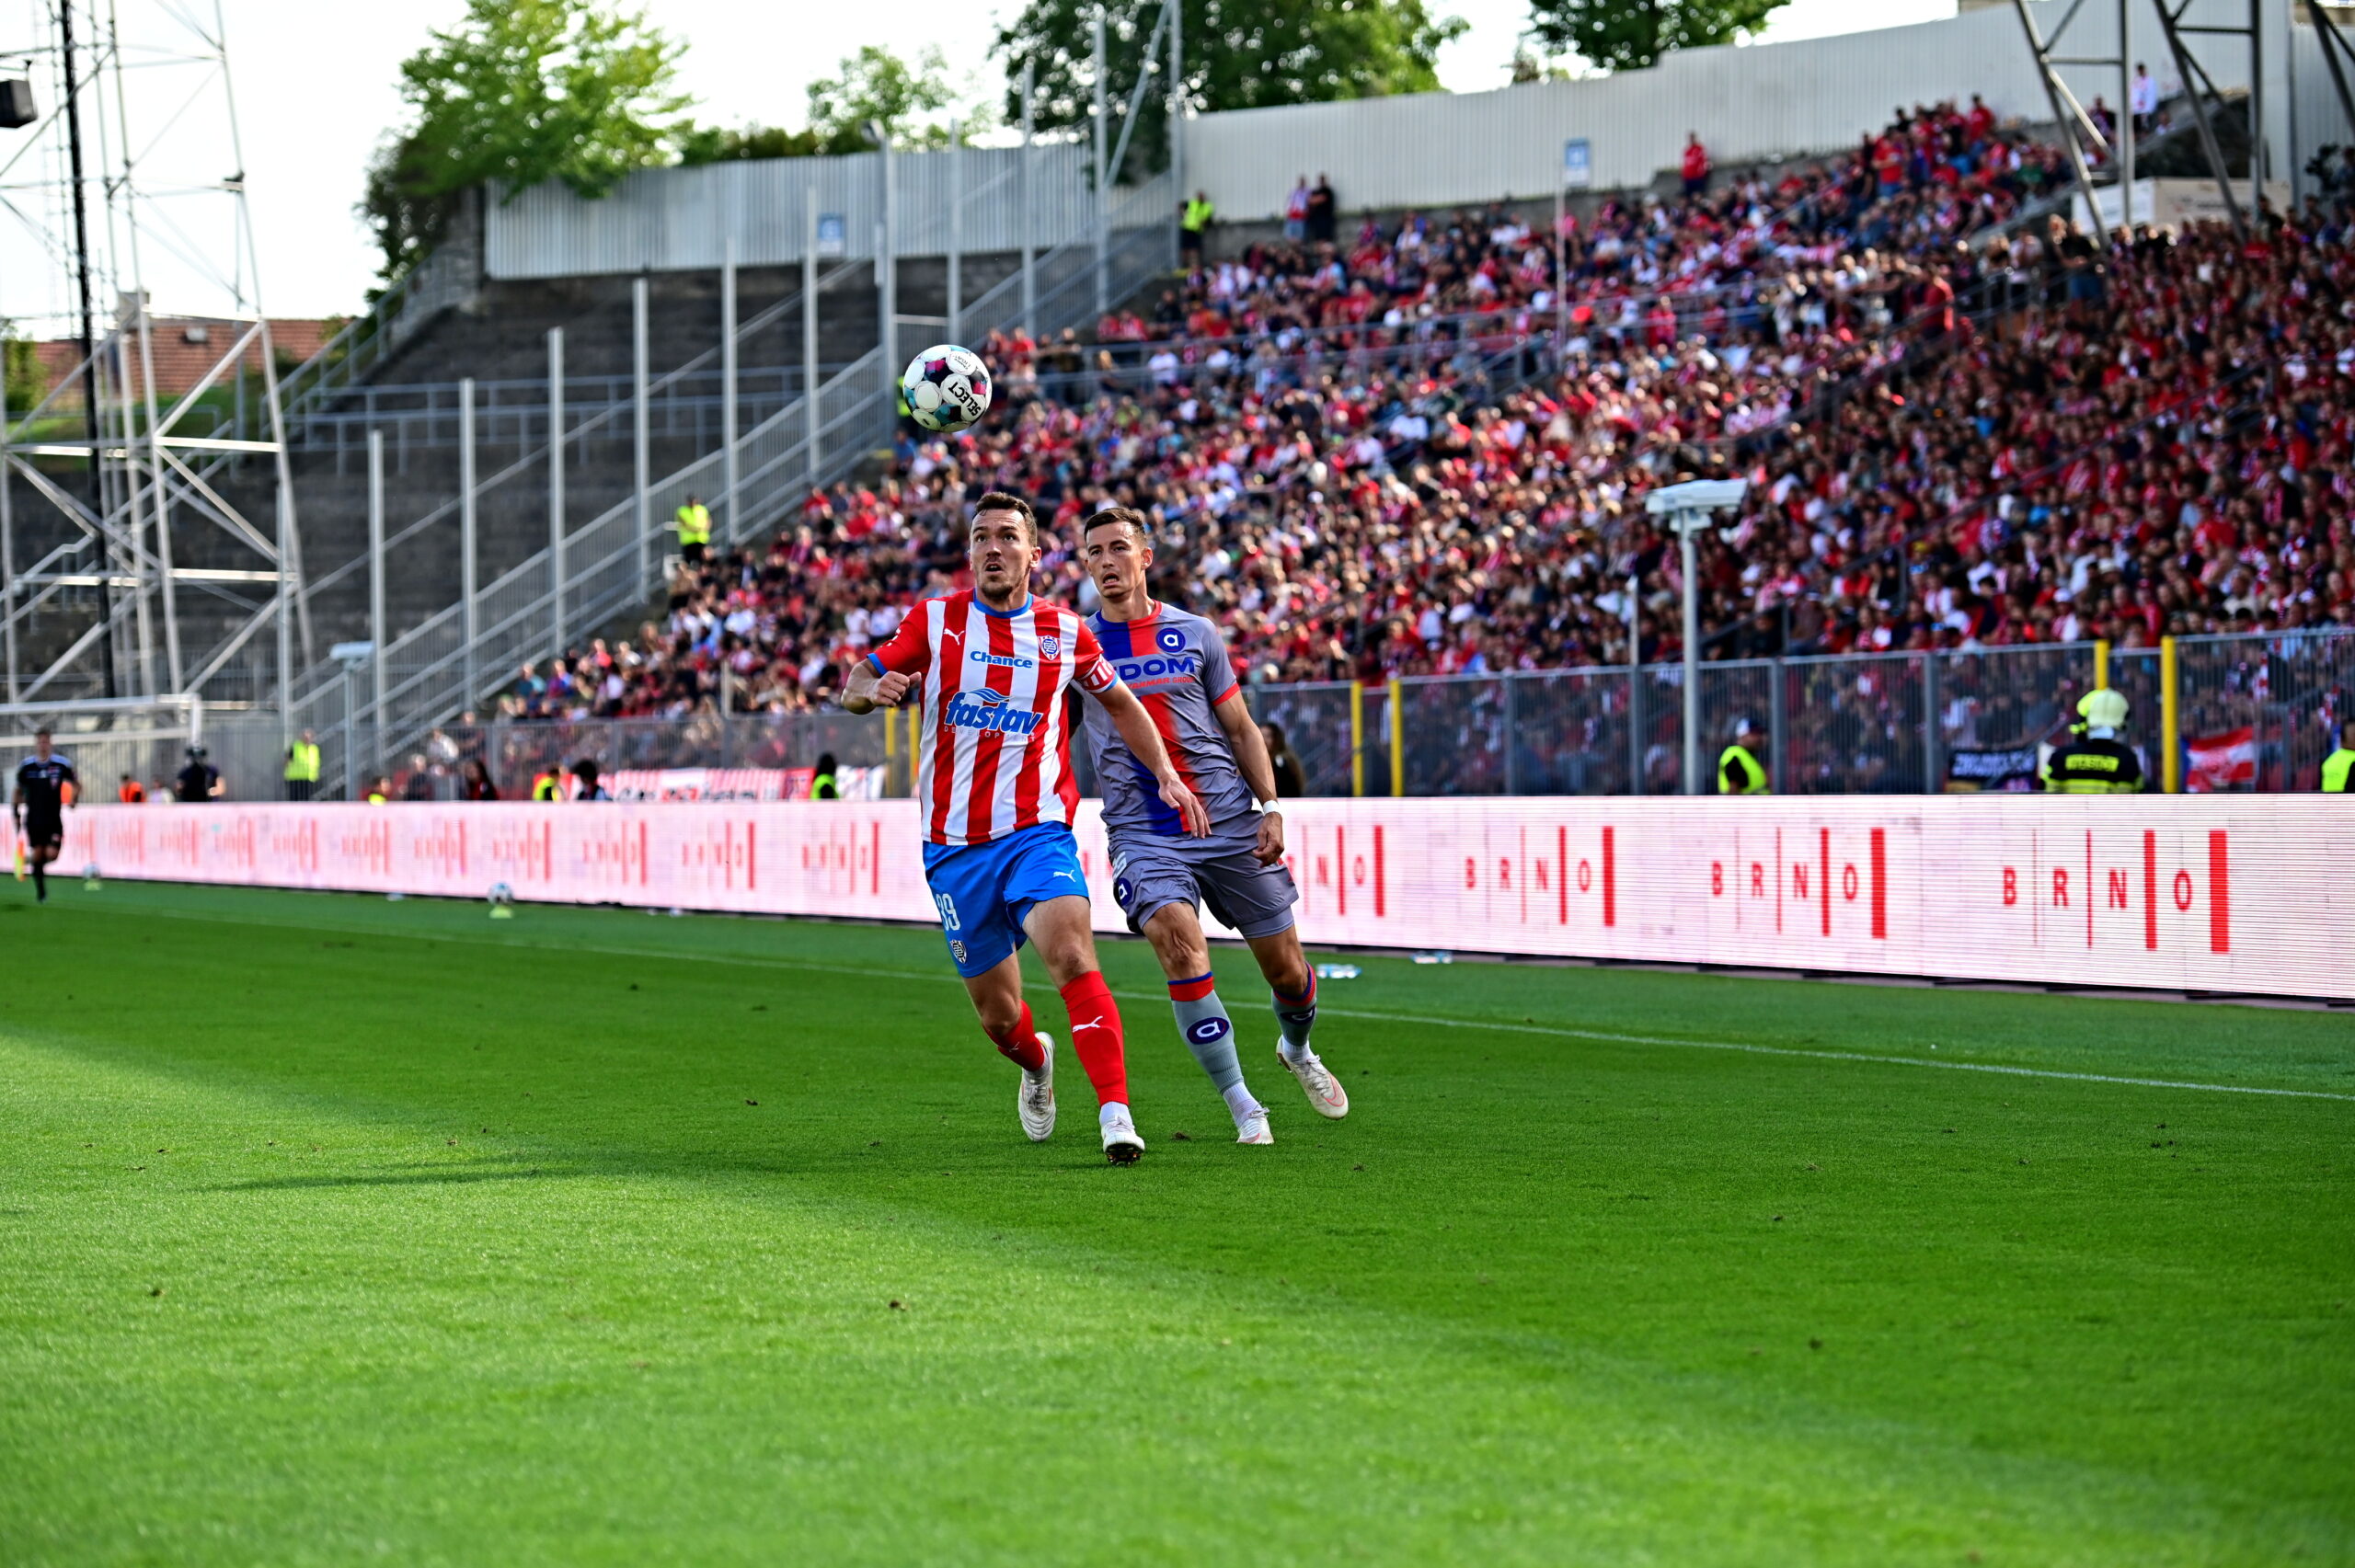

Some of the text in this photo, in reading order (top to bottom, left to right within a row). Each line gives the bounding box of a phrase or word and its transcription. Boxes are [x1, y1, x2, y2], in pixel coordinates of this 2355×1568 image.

[948, 382, 981, 416] SELECT
[970, 650, 1033, 669] Chance
[1114, 656, 1195, 681] DOM
[944, 692, 1044, 735] fastav
[1465, 856, 1591, 892] BRNO
[1712, 861, 1857, 900] BRNO
[2003, 867, 2192, 911] BRNO
